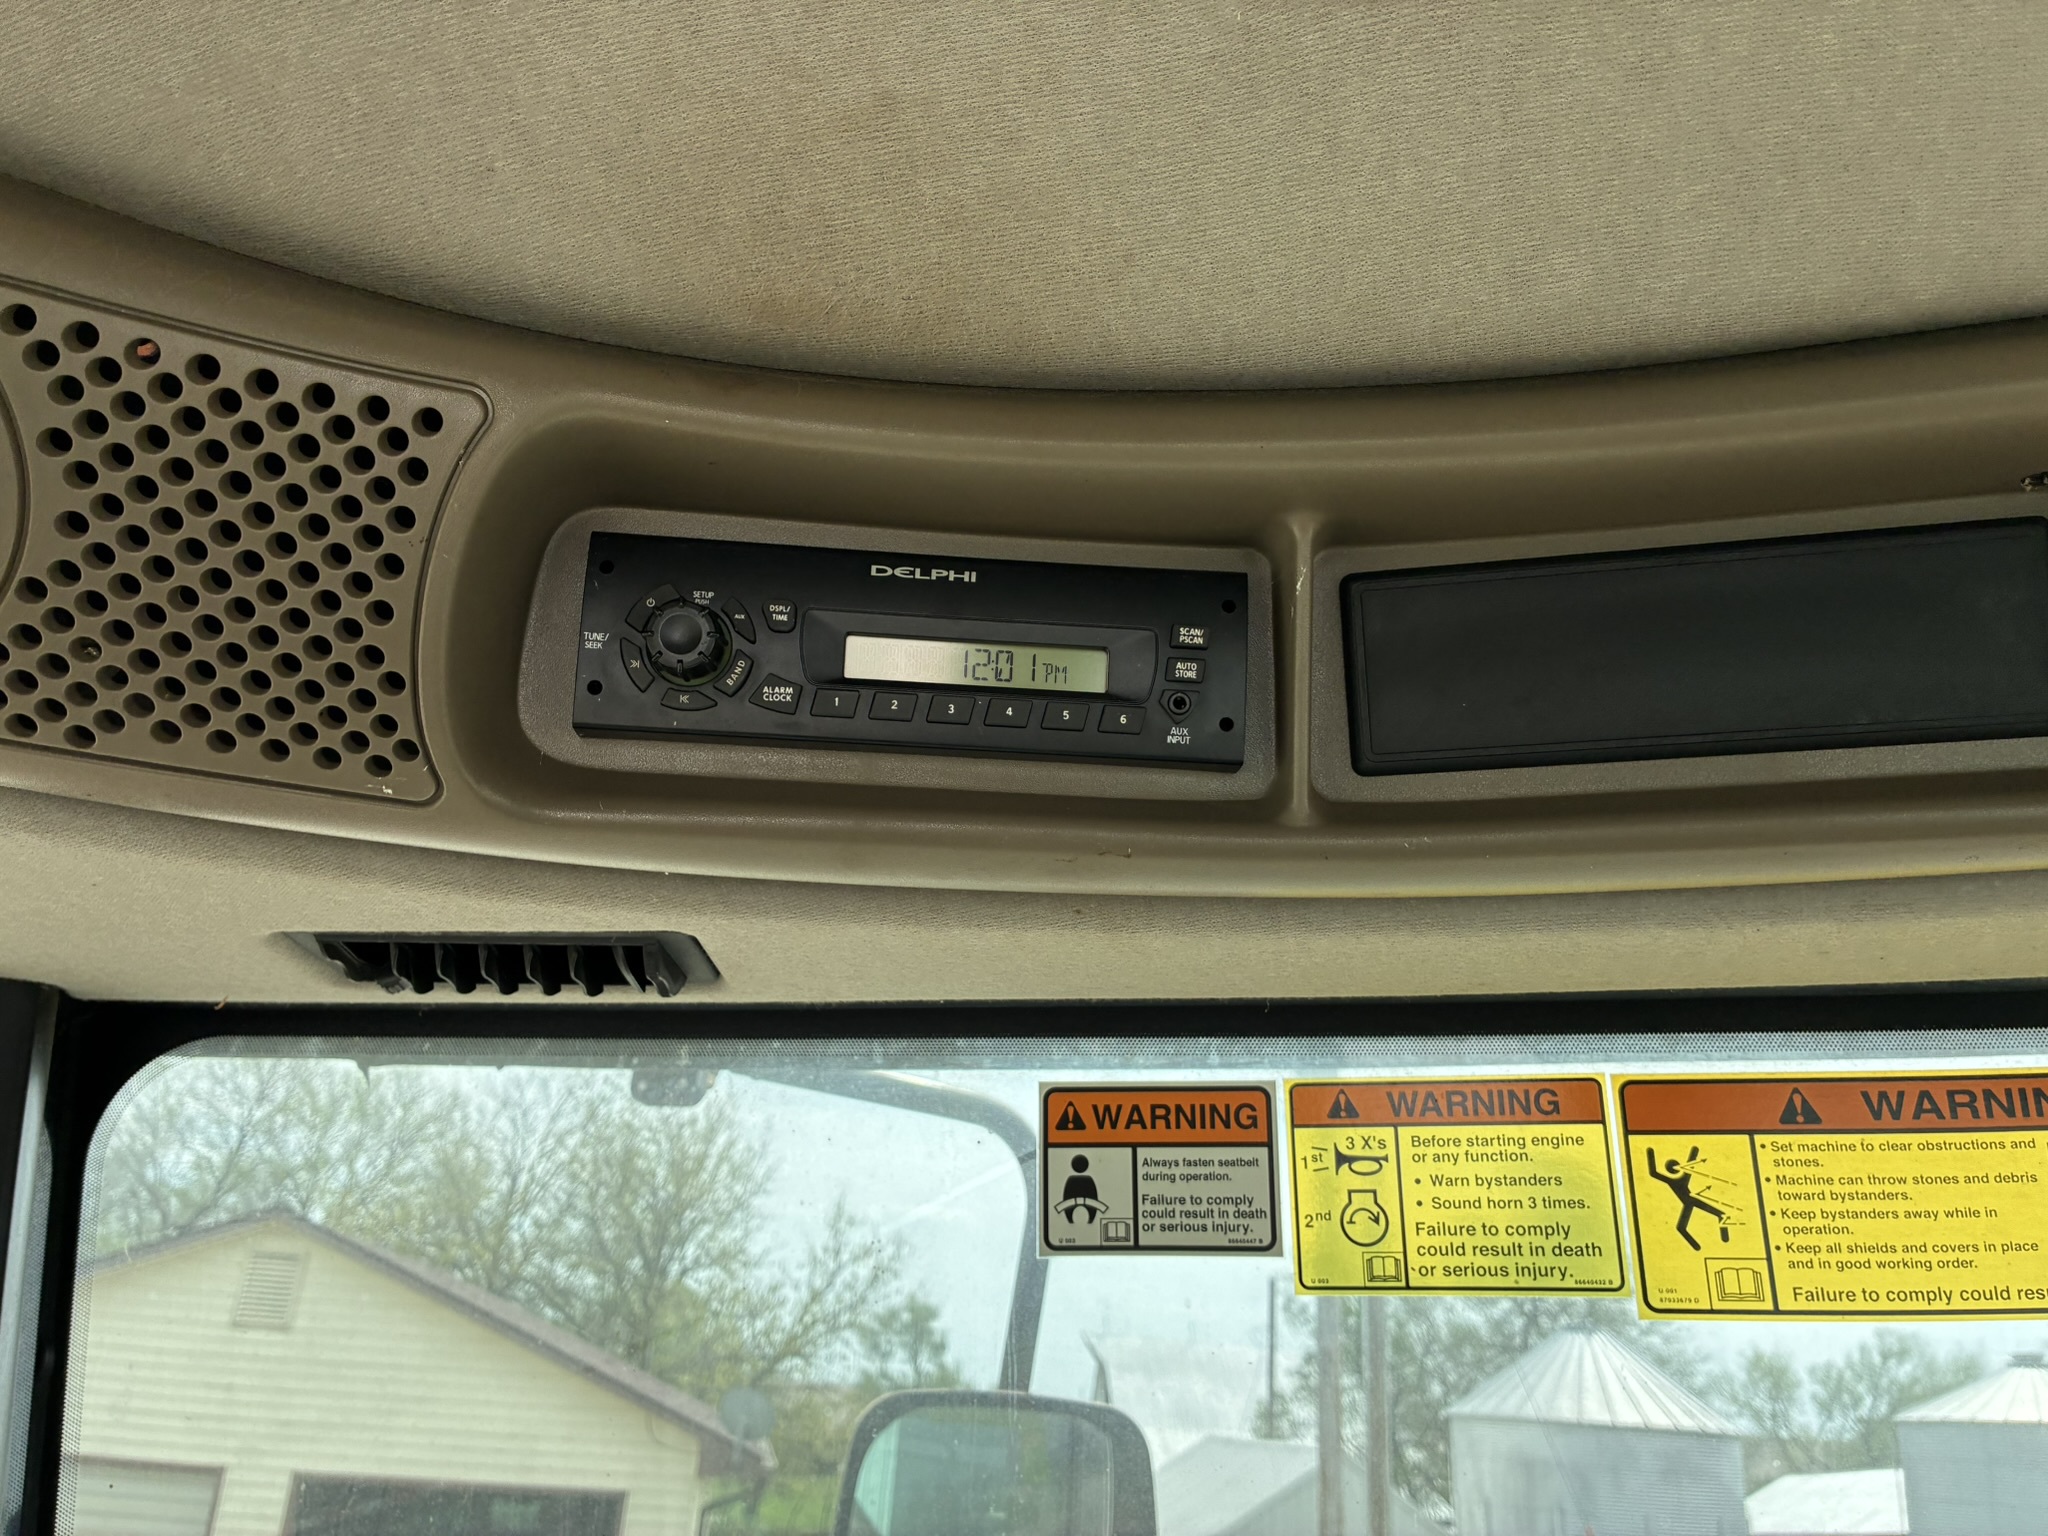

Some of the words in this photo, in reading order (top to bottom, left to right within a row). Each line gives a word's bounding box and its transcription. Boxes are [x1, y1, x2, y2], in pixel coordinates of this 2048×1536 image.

[870, 565, 976, 583] DELPHI
[769, 604, 790, 613] DSPL/
[772, 613, 788, 621] TIME
[584, 632, 609, 641] TUNE/
[1179, 627, 1204, 638] SCAN/
[585, 641, 602, 649] SEEK
[1179, 635, 1204, 645] PSCAN
[963, 649, 1037, 682] 12:01
[1042, 662, 1068, 684] PM
[1175, 661, 1197, 671] AUTO
[726, 660, 745, 686] BAND
[1174, 669, 1197, 679] STORE
[763, 686, 794, 695] ALARM
[763, 693, 792, 702] CLOCK
[834, 697, 839, 706] 1
[891, 700, 898, 709] 2
[948, 704, 954, 713] 3
[1006, 706, 1013, 716] 4
[1063, 711, 1069, 720] 5
[1120, 714, 1127, 724] 6
[1170, 727, 1189, 737] AUX
[1167, 735, 1191, 745] INPUT
[1386, 1089, 1561, 1117] WARNING
[1092, 1103, 1258, 1130] WARNING
[1346, 1137, 1354, 1149] 3
[1360, 1136, 1387, 1149] X's
[1411, 1136, 1461, 1147] Before
[1466, 1134, 1526, 1149] starting
[1531, 1134, 1584, 1149] engine
[1771, 1141, 1793, 1152] Set
[1798, 1141, 1856, 1152] machine
[1860, 1141, 1874, 1152] to
[1879, 1140, 1912, 1152] clear
[1917, 1139, 2006, 1151] obstructions
[2010, 1138, 2036, 1149] and
[1142, 1157, 1179, 1169] Always
[1183, 1157, 1214, 1167] fasten
[1218, 1157, 1259, 1167] seatbelt
[1412, 1153, 1427, 1162] or
[1432, 1152, 1459, 1165] any
[1465, 1150, 1533, 1162] function.
[1773, 1157, 1824, 1167] stones.
[1142, 1171, 1176, 1183] during
[1179, 1171, 1232, 1183] operation.
[1430, 1175, 1470, 1187] Warn
[1475, 1174, 1562, 1189] bystanders
[1776, 1174, 1834, 1185] Machine
[1838, 1176, 1863, 1185] can
[1868, 1174, 1907, 1184] throw
[1912, 1174, 1959, 1184] stones
[1964, 1173, 1989, 1184] and
[1994, 1172, 2038, 1183] debris
[1142, 1194, 1186, 1205] Failure
[1190, 1195, 1202, 1205] to
[1207, 1195, 1254, 1208] comply
[1778, 1190, 1825, 1200] toward
[1830, 1190, 1912, 1203] bystanders.
[1432, 1197, 1481, 1209] Sound
[1487, 1197, 1523, 1209] horn
[1528, 1197, 1537, 1209] 3
[1543, 1197, 1590, 1209] times.
[1142, 1208, 1175, 1219] could
[1180, 1208, 1214, 1219] result
[1218, 1208, 1229, 1218] in
[1233, 1208, 1267, 1219] death
[1305, 1209, 1332, 1227] 2nd
[1781, 1208, 1816, 1221] Keep
[1820, 1208, 1899, 1221] bystanders
[1904, 1210, 1938, 1221] away
[1944, 1207, 1980, 1218] while
[1985, 1207, 1997, 1218] in
[1142, 1223, 1155, 1232] or
[1160, 1221, 1208, 1232] serious
[1212, 1221, 1253, 1235] injury.
[1415, 1222, 1476, 1236] Failure
[1482, 1223, 1498, 1236] to
[1505, 1222, 1571, 1239] comply
[1783, 1224, 1854, 1237] operation.
[1417, 1242, 1466, 1257] could
[1473, 1242, 1523, 1257] result
[1529, 1242, 1545, 1256] in
[1552, 1242, 1602, 1257] death
[1786, 1242, 1821, 1256] Keep
[1826, 1242, 1842, 1253] all
[1847, 1242, 1897, 1253] shields
[1902, 1242, 1927, 1253] and
[1932, 1244, 1979, 1253] covers
[1983, 1241, 1996, 1252] in
[2001, 1241, 2039, 1255] place
[1418, 1265, 1436, 1277] or
[1443, 1263, 1509, 1277] serious
[1515, 1262, 1573, 1280] injury.
[1788, 1258, 1814, 1269] and
[1818, 1258, 1831, 1269] in
[1836, 1258, 1871, 1271] good
[1876, 1258, 1932, 1272] working
[1937, 1258, 1977, 1268] order.
[1793, 1287, 1856, 1302] Failure
[1862, 1288, 1879, 1302] to
[1886, 1286, 1952, 1306] comply
[1960, 1285, 2010, 1301] could
[2017, 1287, 2048, 1300] res
